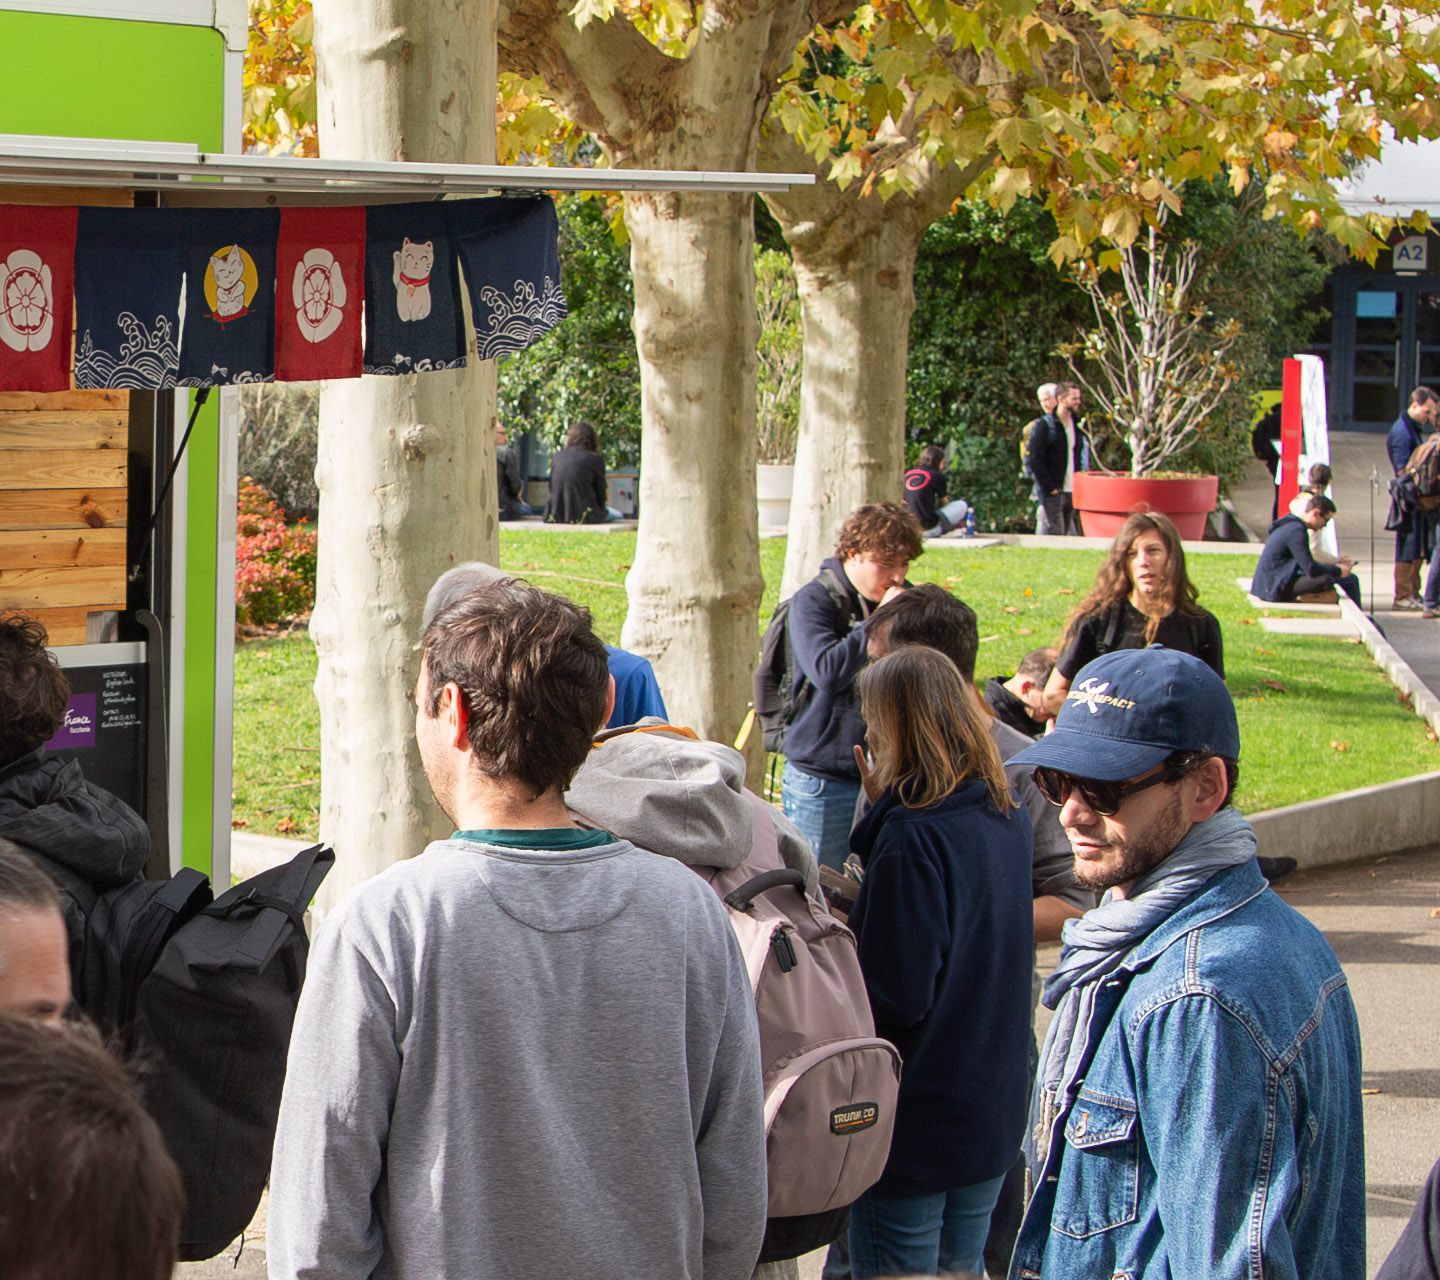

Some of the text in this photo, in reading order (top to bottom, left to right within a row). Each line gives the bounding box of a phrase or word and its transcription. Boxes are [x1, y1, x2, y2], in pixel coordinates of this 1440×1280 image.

[1397, 245, 1423, 260] A2
[64, 708, 91, 728] France
[834, 1110, 862, 1124] TRUNK
